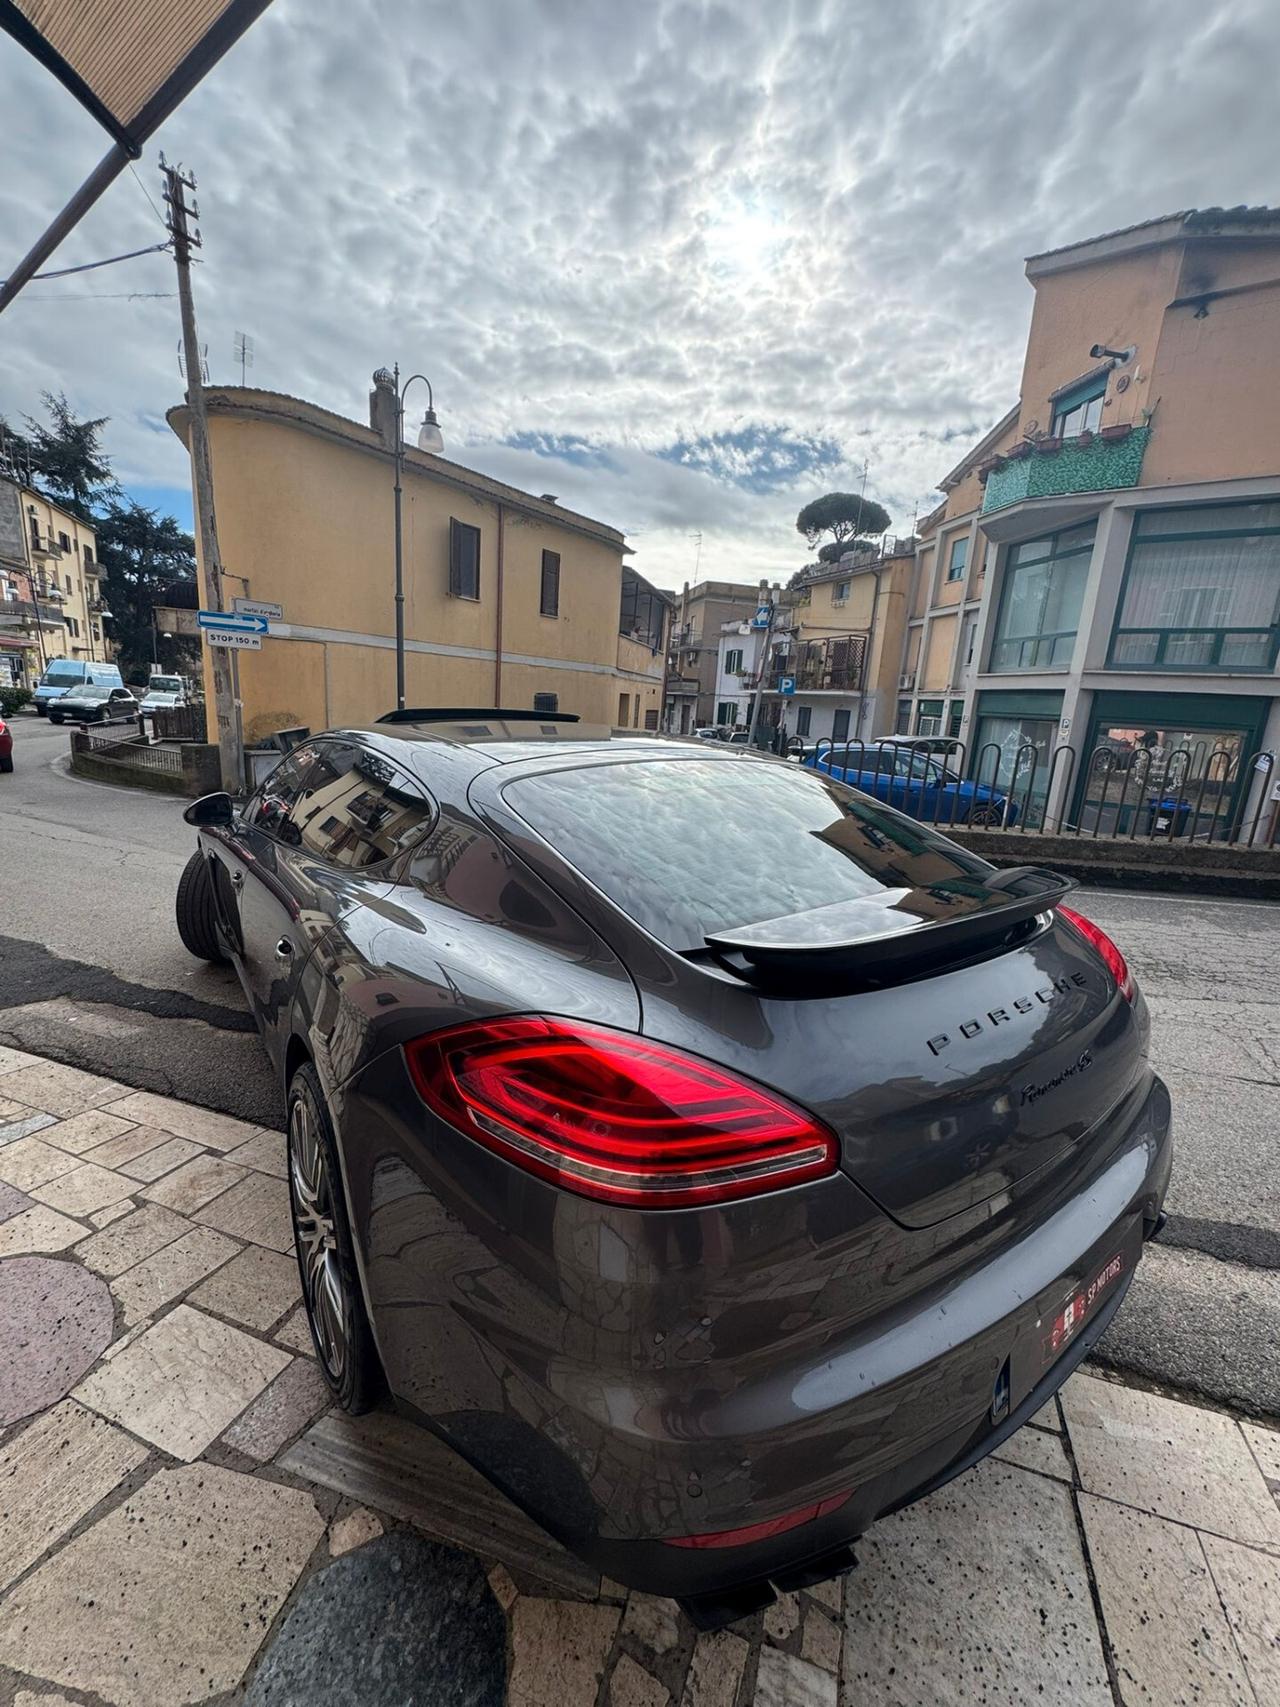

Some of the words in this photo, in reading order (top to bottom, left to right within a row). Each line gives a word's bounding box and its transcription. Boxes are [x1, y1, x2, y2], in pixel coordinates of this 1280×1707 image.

[210, 634, 233, 642] STOP
[781, 678, 793, 693] P
[926, 971, 1087, 1056] PORSCHE
[1087, 1282, 1097, 1305] SP
[1096, 1255, 1121, 1292] MOTORS
